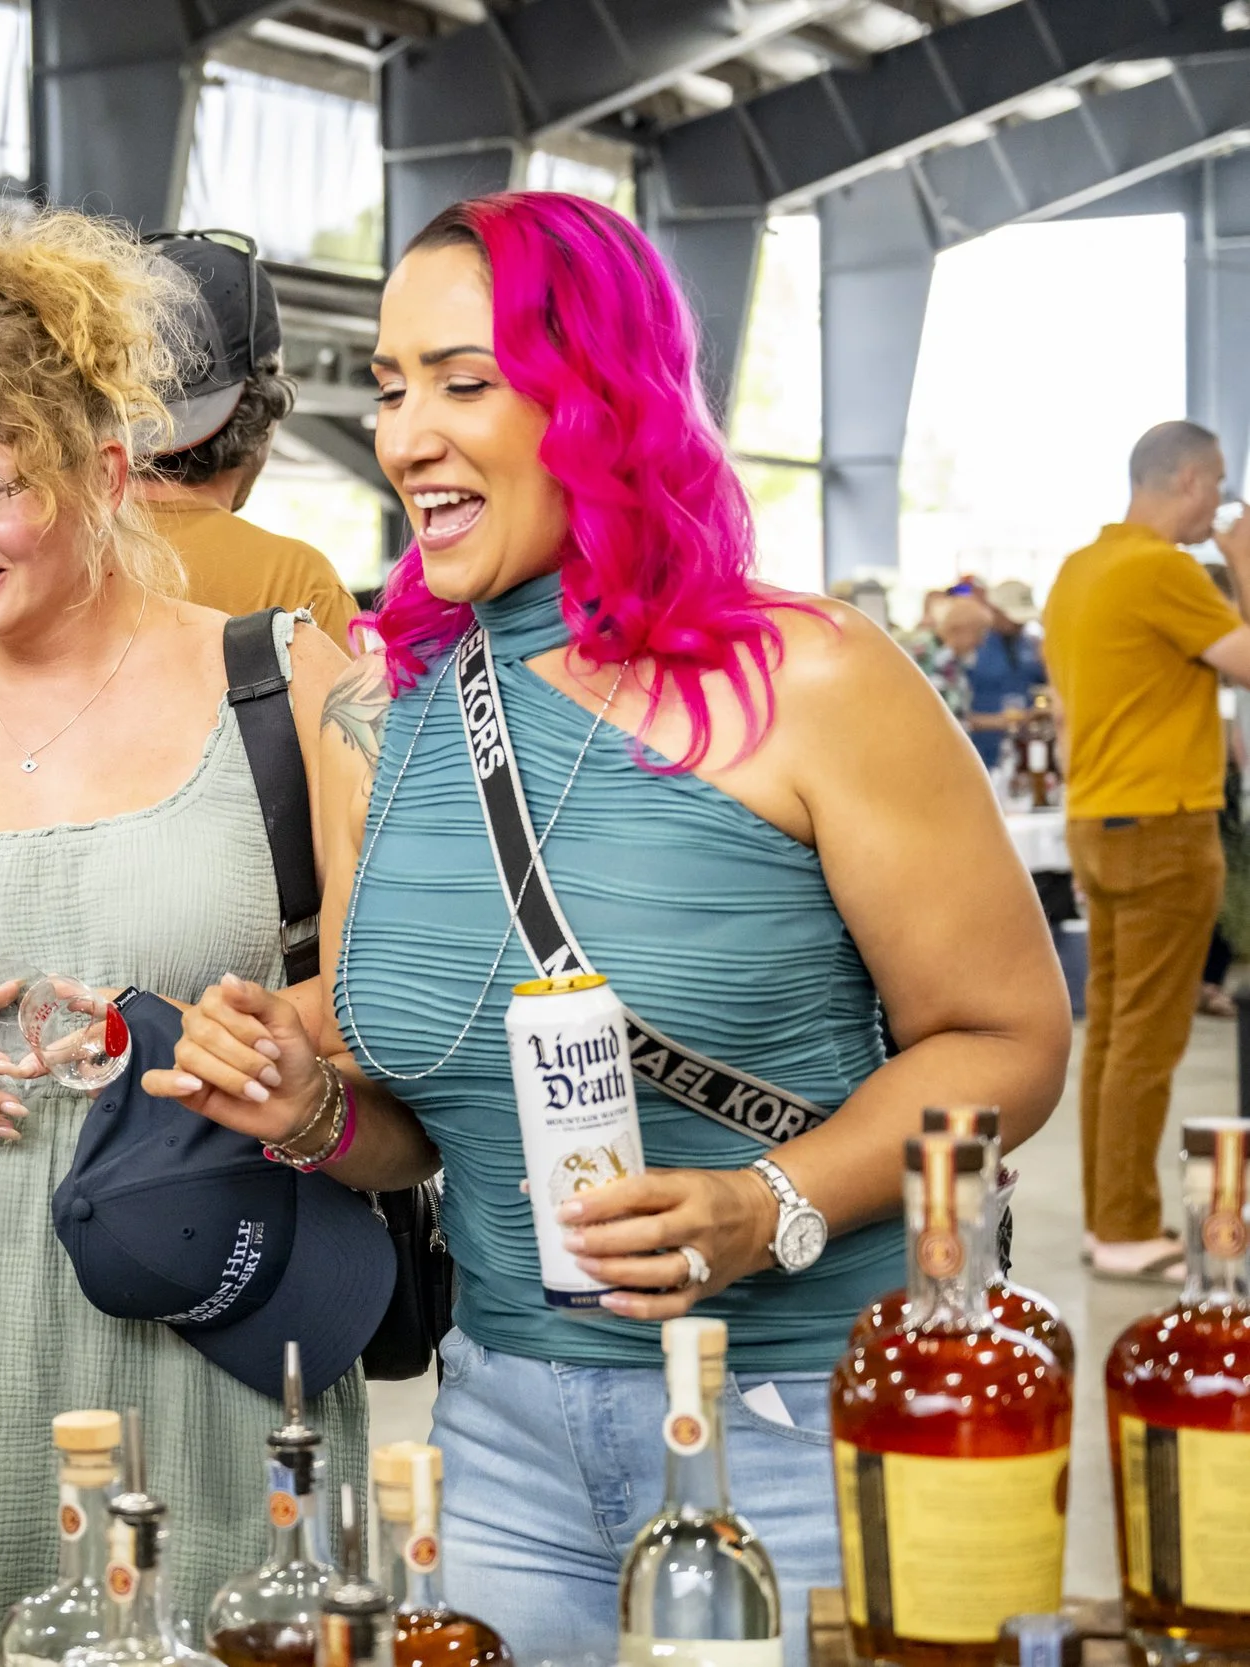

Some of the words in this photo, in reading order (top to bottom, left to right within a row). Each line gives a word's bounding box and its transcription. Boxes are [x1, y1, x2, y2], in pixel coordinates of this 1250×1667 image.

[462, 669, 505, 780] KORS
[528, 1024, 620, 1077] Liquid
[541, 1064, 626, 1110] Death
[190, 1248, 262, 1322] DISTILLERY
